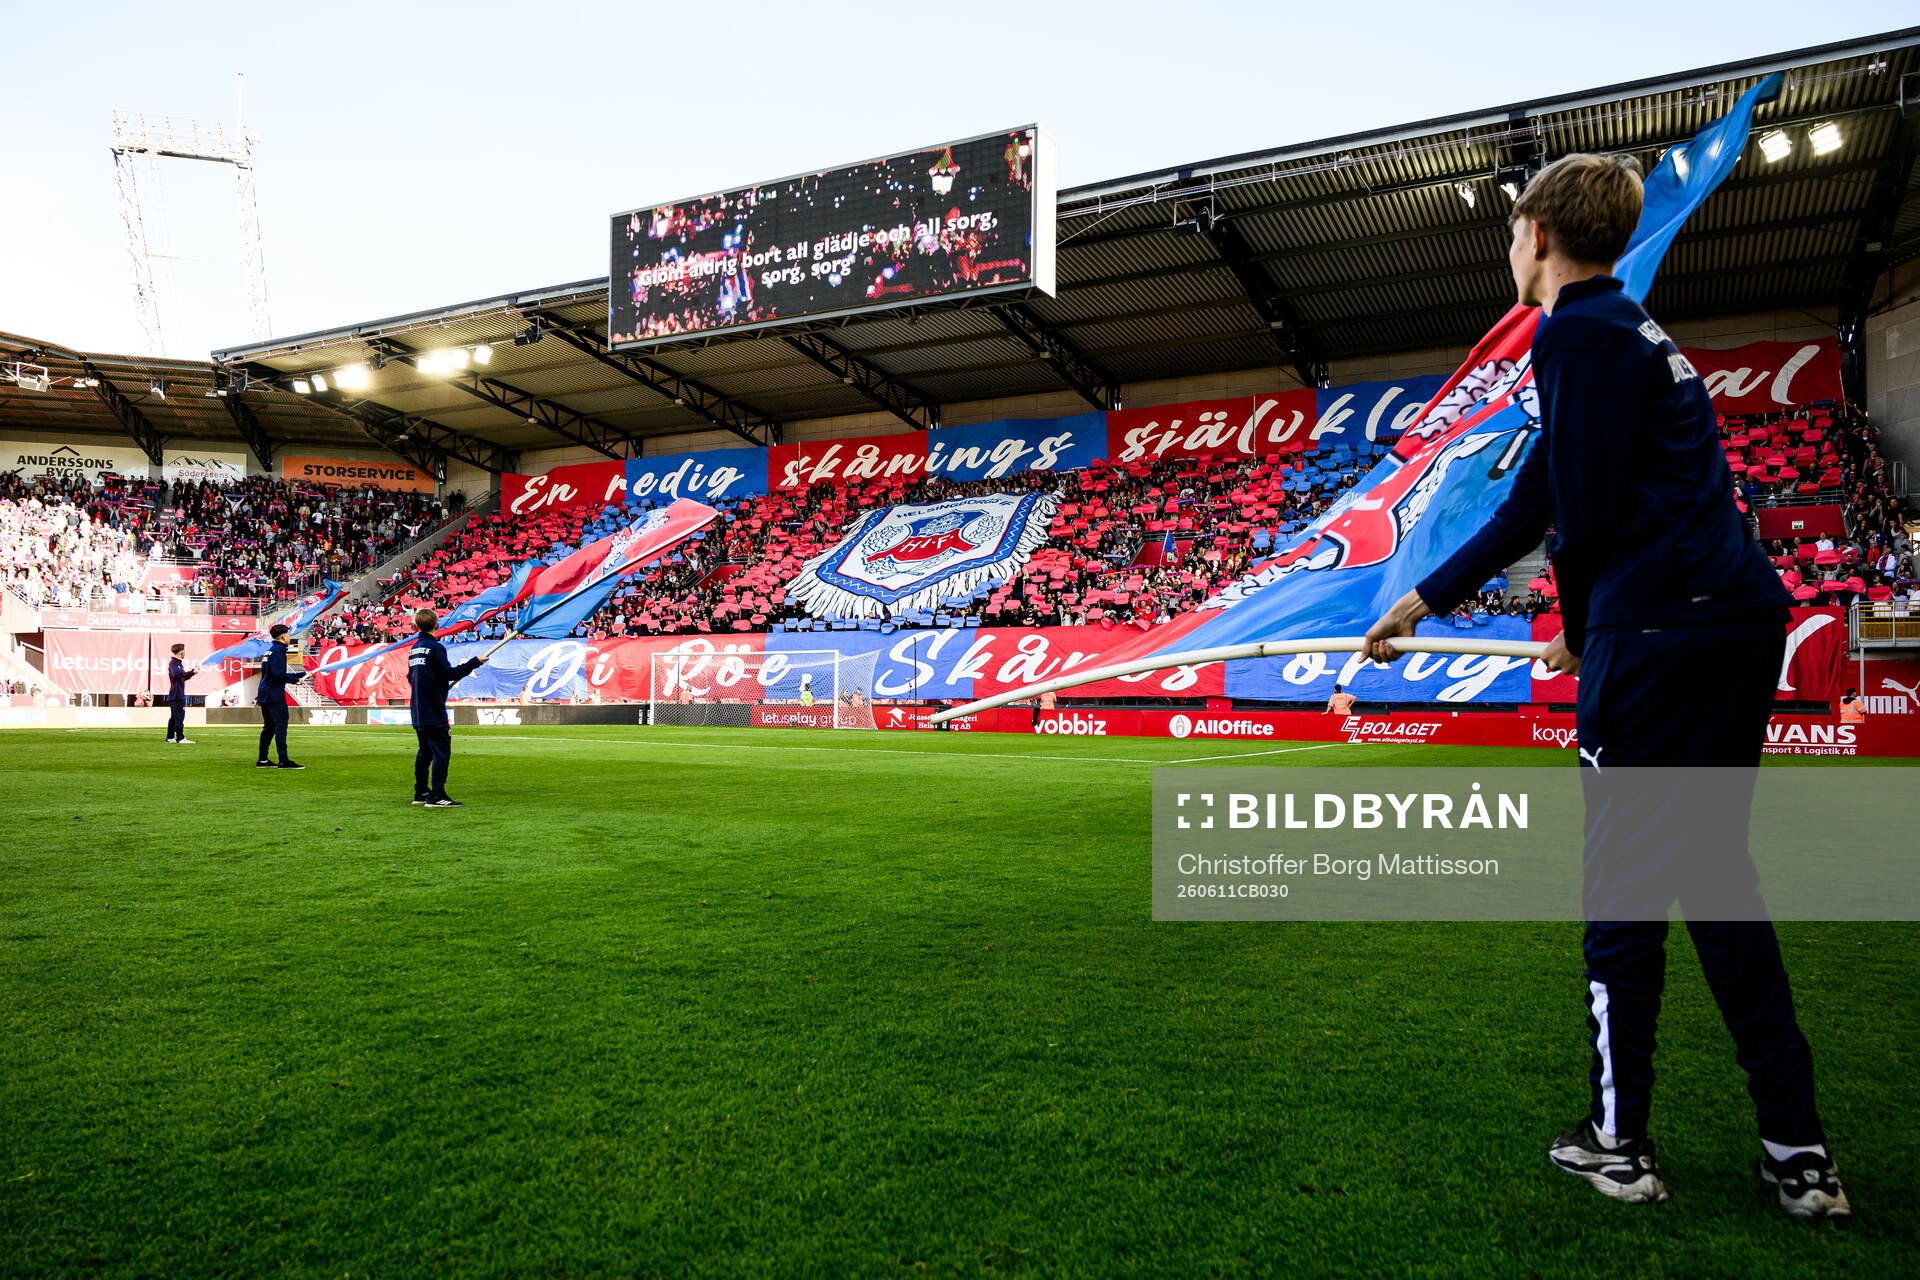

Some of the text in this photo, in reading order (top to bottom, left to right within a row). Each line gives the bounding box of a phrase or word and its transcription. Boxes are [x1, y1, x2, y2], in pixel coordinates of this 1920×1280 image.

[689, 257, 738, 275] aldrig
[742, 249, 781, 269] bort
[787, 242, 808, 261] all
[814, 232, 870, 260] glädje
[876, 224, 911, 244] och
[917, 217, 941, 237] all
[947, 211, 998, 232] sorg,
[761, 258, 851, 285] sorg, sorg
[16, 455, 114, 469] ANDERSSONS
[46, 467, 84, 478] BYGG
[303, 464, 416, 480] STORSERVICE
[511, 475, 578, 514] En
[605, 458, 745, 501] redig
[779, 431, 1076, 487] skånings
[1194, 719, 1274, 736] AllOffice
[1804, 747, 1841, 756] Logistik
[1843, 748, 1856, 756] AB
